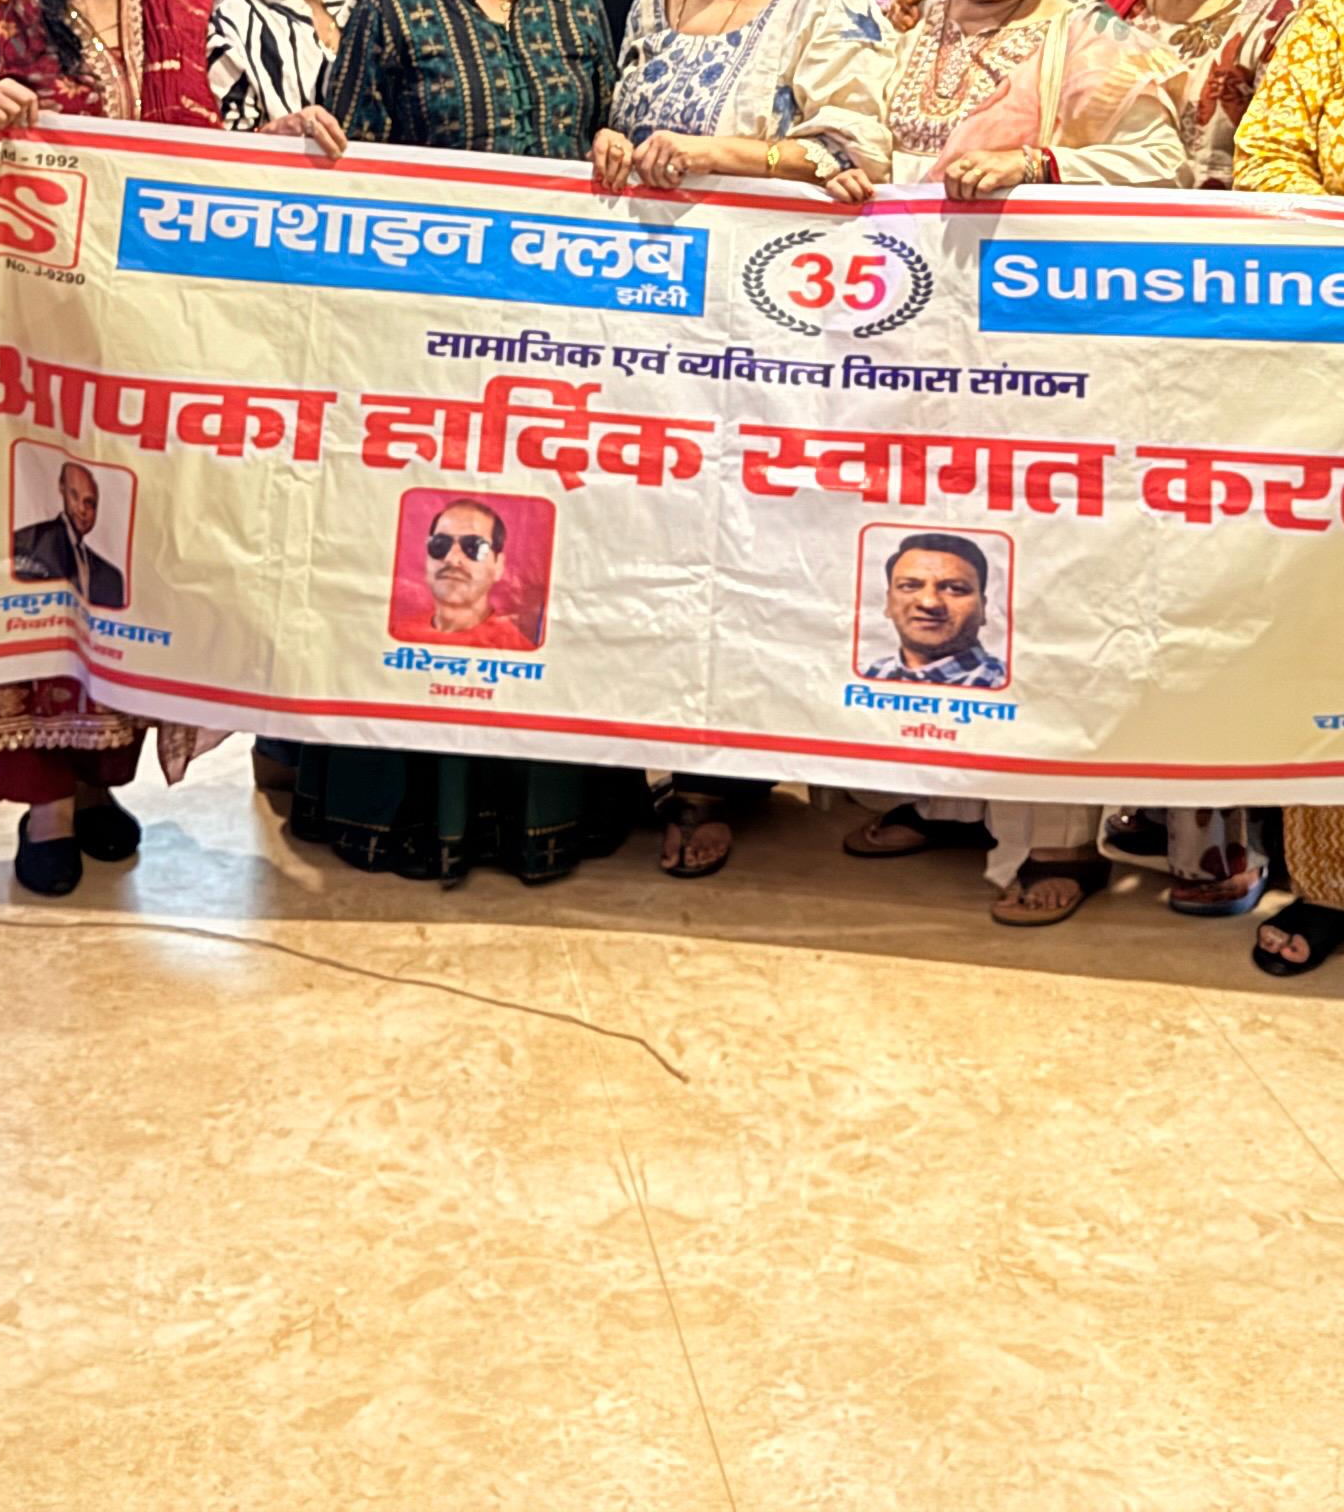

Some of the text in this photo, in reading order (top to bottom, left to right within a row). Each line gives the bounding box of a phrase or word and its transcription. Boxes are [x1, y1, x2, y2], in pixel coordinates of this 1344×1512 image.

[35, 153, 80, 169] 1992
[138, 188, 693, 283] सनशाइन क्लब
[6, 259, 31, 274] No.
[787, 252, 887, 311] 35
[425, 329, 604, 369] सामाजिक
[613, 343, 674, 377] एवं
[840, 354, 960, 394] विकास
[968, 360, 1089, 399] संगठन
[361, 374, 716, 488] हार्दिक
[739, 422, 1116, 519] स्वागत
[383, 647, 546, 683] वीरेन्द्र गुप्ता
[844, 684, 1018, 724] विलास गुप्ता
[900, 723, 959, 741] सचिव
